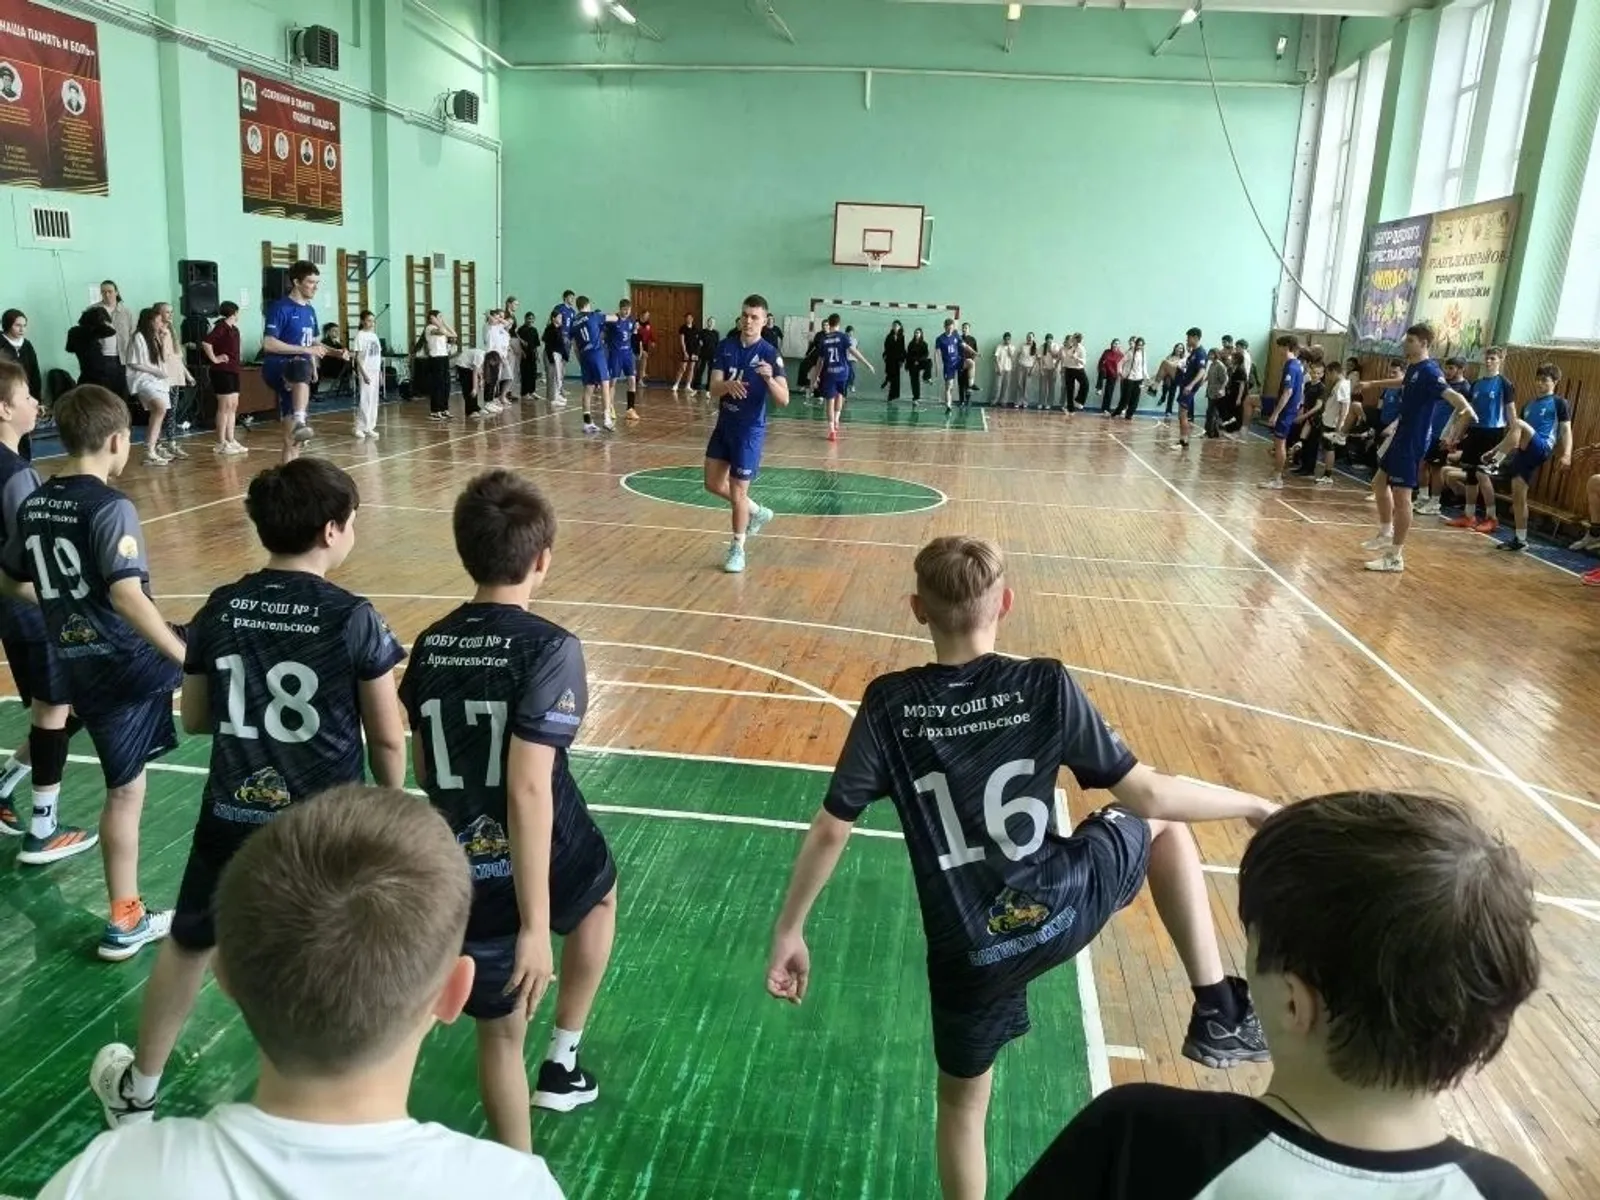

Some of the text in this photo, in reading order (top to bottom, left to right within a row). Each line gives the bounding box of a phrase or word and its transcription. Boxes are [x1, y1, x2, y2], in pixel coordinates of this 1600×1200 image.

[25, 534, 91, 600] 19
[229, 597, 259, 612] ОБУ
[260, 601, 290, 615] СОШ
[232, 617, 321, 635] рхангельское
[214, 653, 321, 744] 18
[903, 690, 1025, 718] МОБУ СОШ № 1
[420, 698, 508, 790] 17
[917, 711, 1032, 741] Архангельское
[913, 758, 1050, 871] 16
